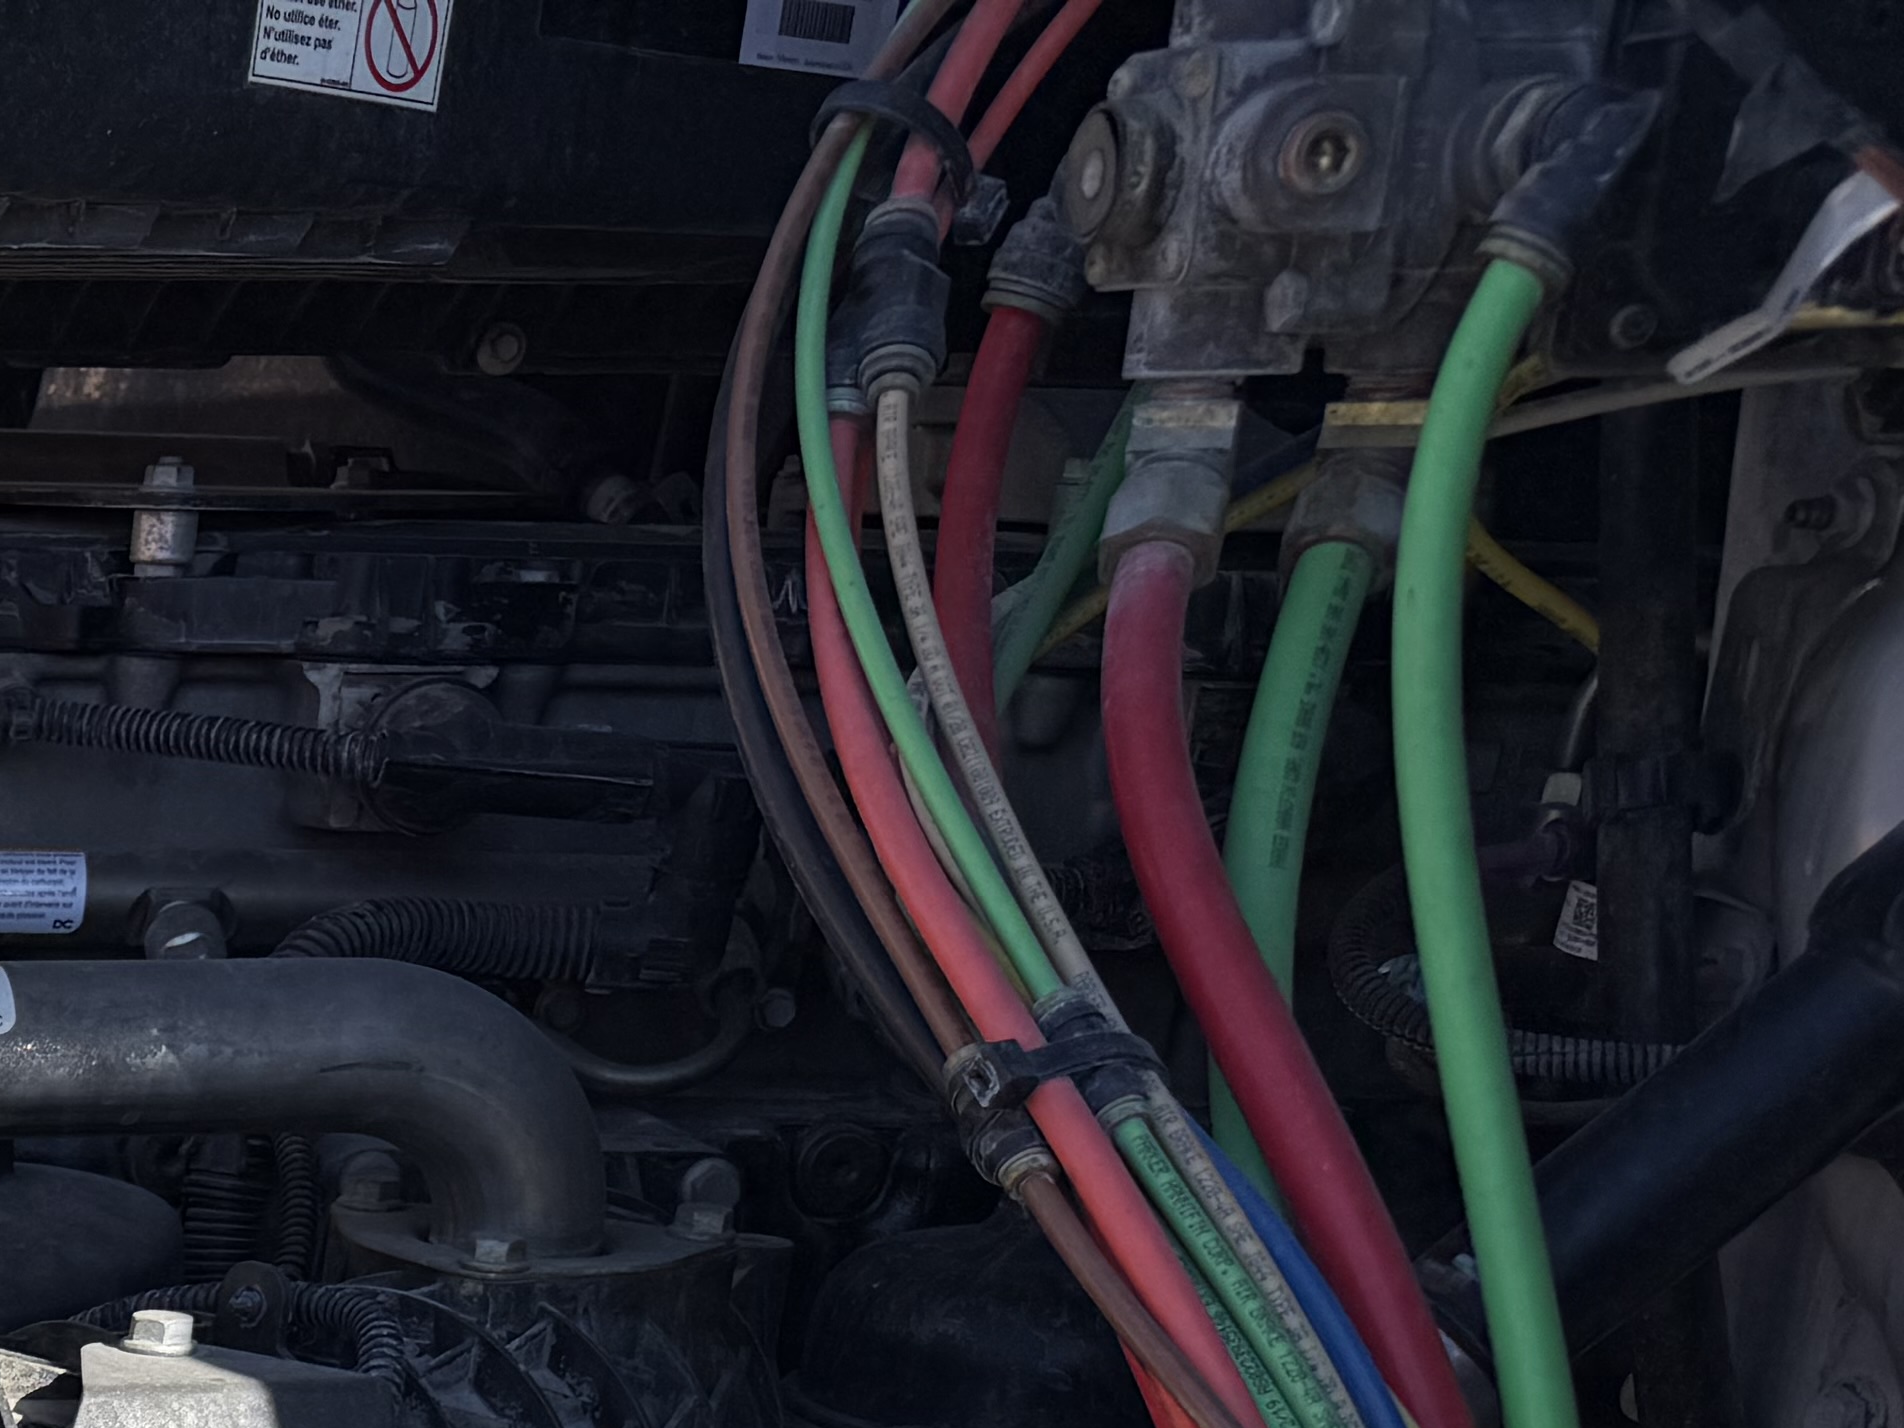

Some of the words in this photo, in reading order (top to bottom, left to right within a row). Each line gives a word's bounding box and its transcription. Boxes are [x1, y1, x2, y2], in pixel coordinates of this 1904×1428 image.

[265, 5, 281, 21] No
[318, 14, 341, 31] éter.
[314, 37, 334, 51] pas
[988, 806, 1028, 865] EXTRUDED
[1027, 879, 1049, 903] THE
[52, 919, 74, 929] DC
[1228, 1275, 1254, 1303] AIR
